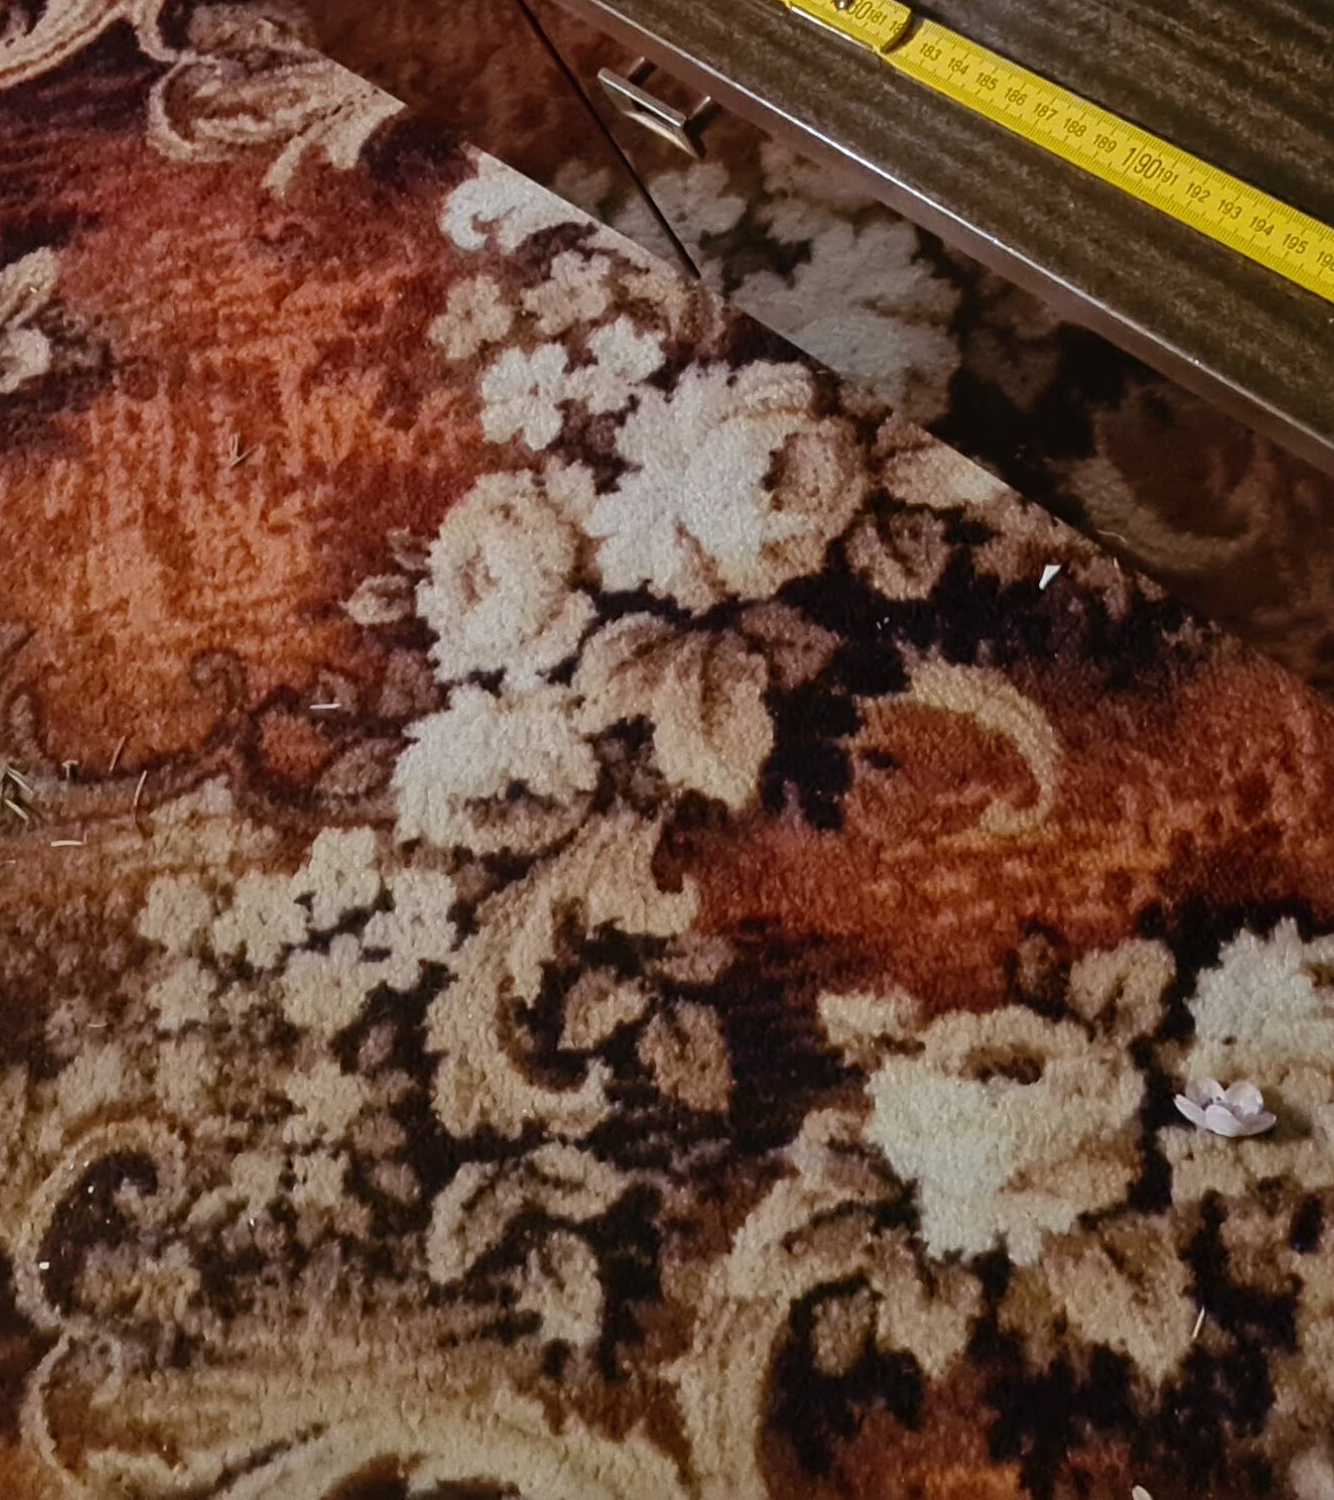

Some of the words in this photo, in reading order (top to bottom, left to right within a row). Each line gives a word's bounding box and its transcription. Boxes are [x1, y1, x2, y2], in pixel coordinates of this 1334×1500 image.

[867, 8, 888, 26] 181
[920, 43, 943, 61] 183
[947, 58, 970, 75] 184
[976, 72, 999, 90] 185
[1004, 87, 1028, 106] 186
[1033, 102, 1058, 120] 187
[1063, 118, 1087, 137] 188
[1093, 133, 1117, 152] 189
[1122, 148, 1162, 179] 190
[1158, 167, 1179, 186] 191
[1186, 182, 1211, 202] 192
[1217, 199, 1243, 219] 193
[1248, 216, 1274, 236] 194
[1282, 233, 1308, 254] 195
